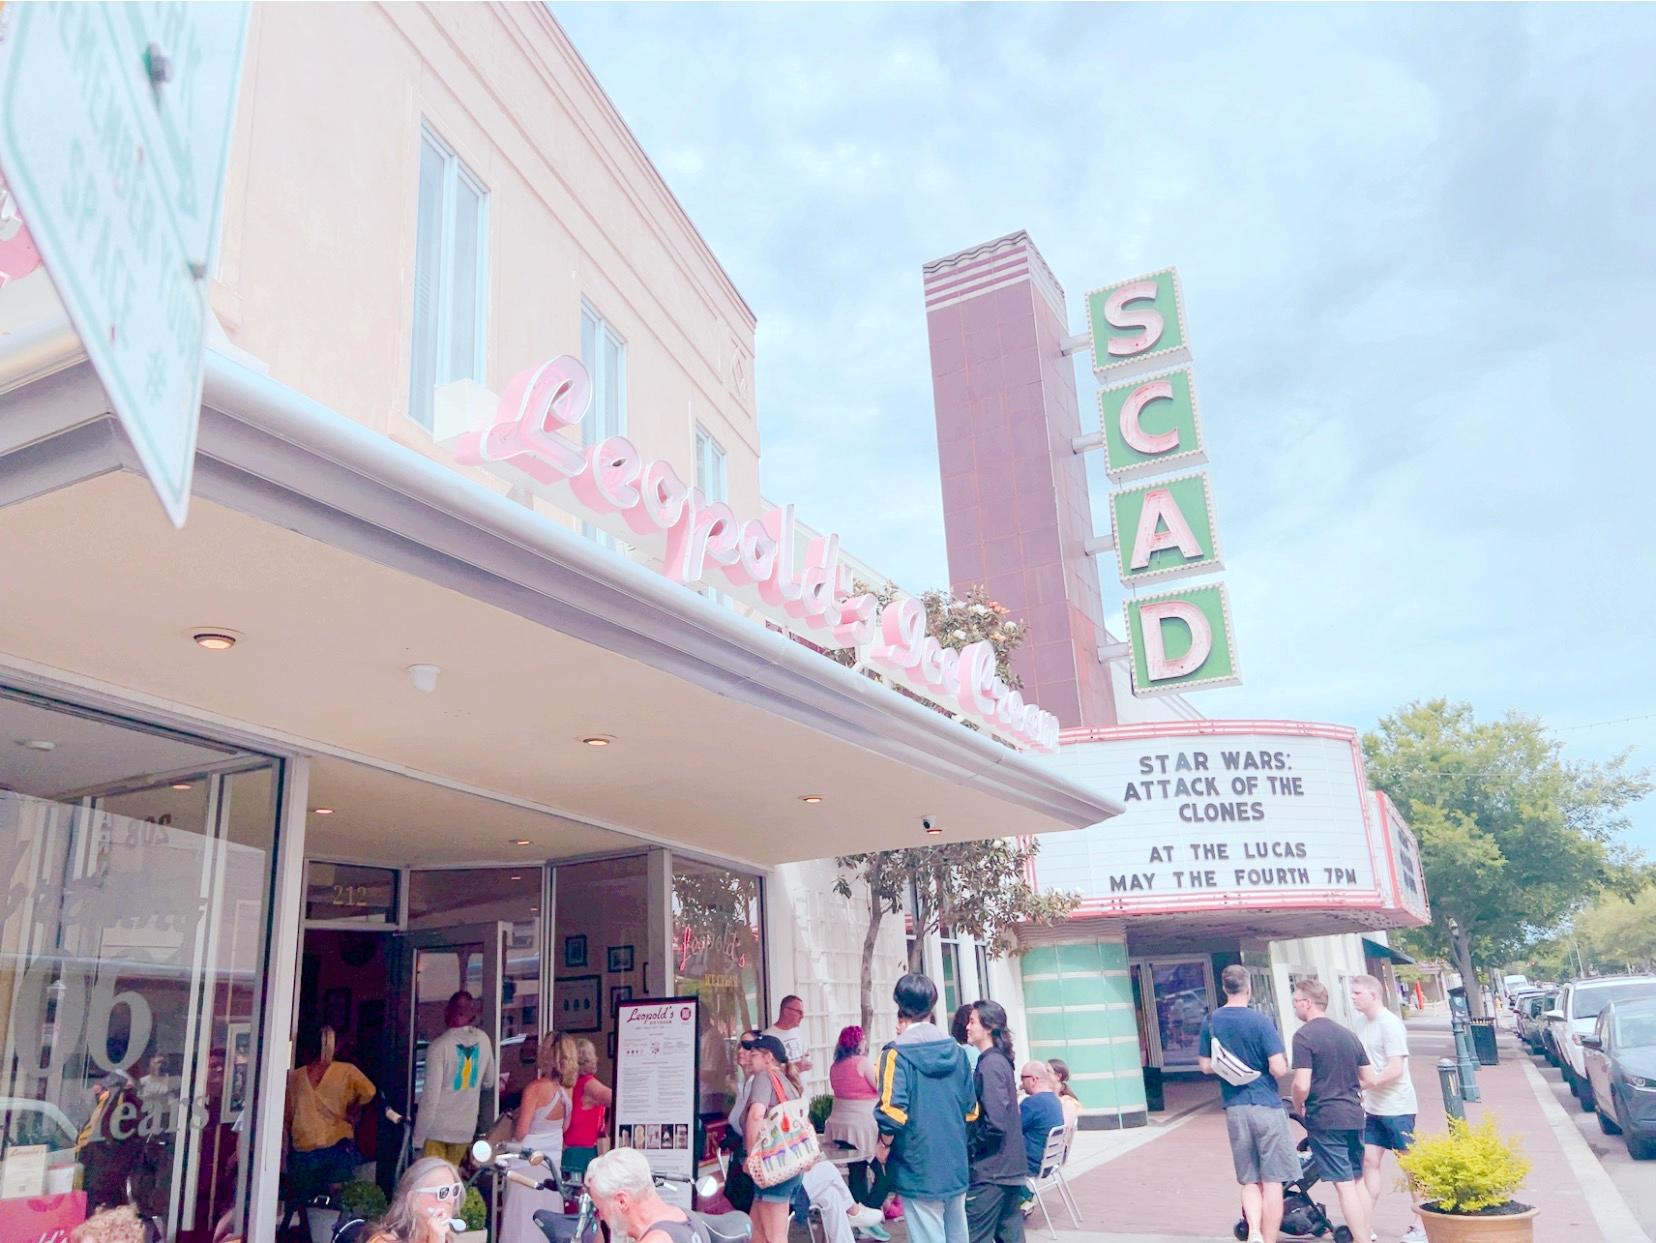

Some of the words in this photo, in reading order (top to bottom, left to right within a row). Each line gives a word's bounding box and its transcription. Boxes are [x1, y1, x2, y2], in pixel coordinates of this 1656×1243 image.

[1104, 280, 1212, 682] SCAD
[456, 354, 877, 647] Leopold's
[1139, 752, 1209, 775] STAR
[1220, 751, 1293, 771] WARS:
[1124, 777, 1220, 801] ATTACK
[1231, 776, 1259, 796] OF
[1266, 776, 1304, 796] THE
[1179, 802, 1265, 823] CLONES
[1149, 845, 1174, 863] AT
[1190, 843, 1229, 861] THE
[1243, 842, 1307, 859] LUCAS
[1109, 873, 1155, 892] MAY
[1173, 870, 1217, 888] THE
[1234, 867, 1310, 886] FOURTH
[1324, 867, 1357, 885] 7PM
[332, 884, 368, 906] 212
[627, 1006, 675, 1024] Leopold's
